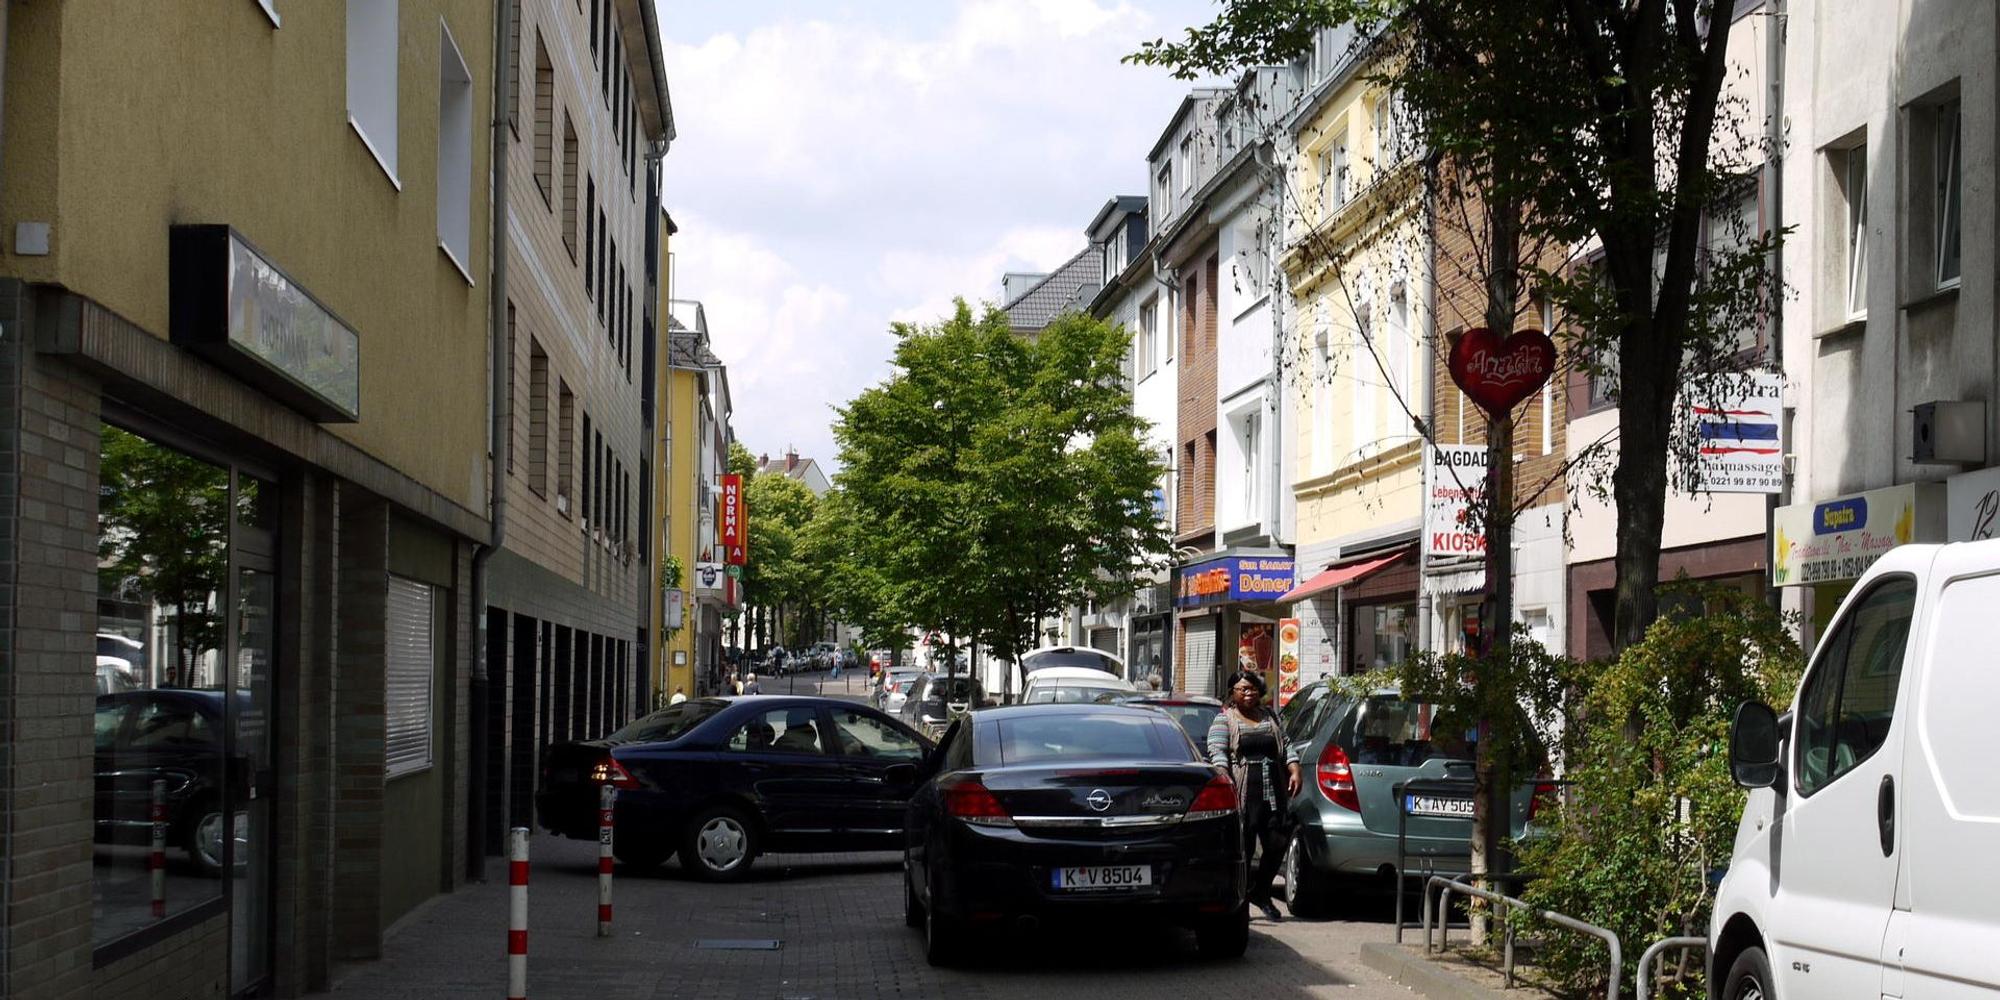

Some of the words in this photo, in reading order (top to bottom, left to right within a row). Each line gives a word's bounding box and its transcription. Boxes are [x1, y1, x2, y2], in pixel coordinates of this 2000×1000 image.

[1711, 477, 1730, 486] 0221
[1734, 478, 1744, 486] 99
[1746, 478, 1756, 486] 87
[1759, 478, 1769, 486] 90
[1772, 478, 1782, 486] 89
[726, 485, 736, 536] NORMA
[1240, 574, 1292, 592] Döner
[1414, 796, 1423, 810] K
[1432, 798, 1448, 810] AY
[1065, 869, 1076, 886] K
[1087, 868, 1098, 885] V
[1102, 867, 1142, 884] 8504
